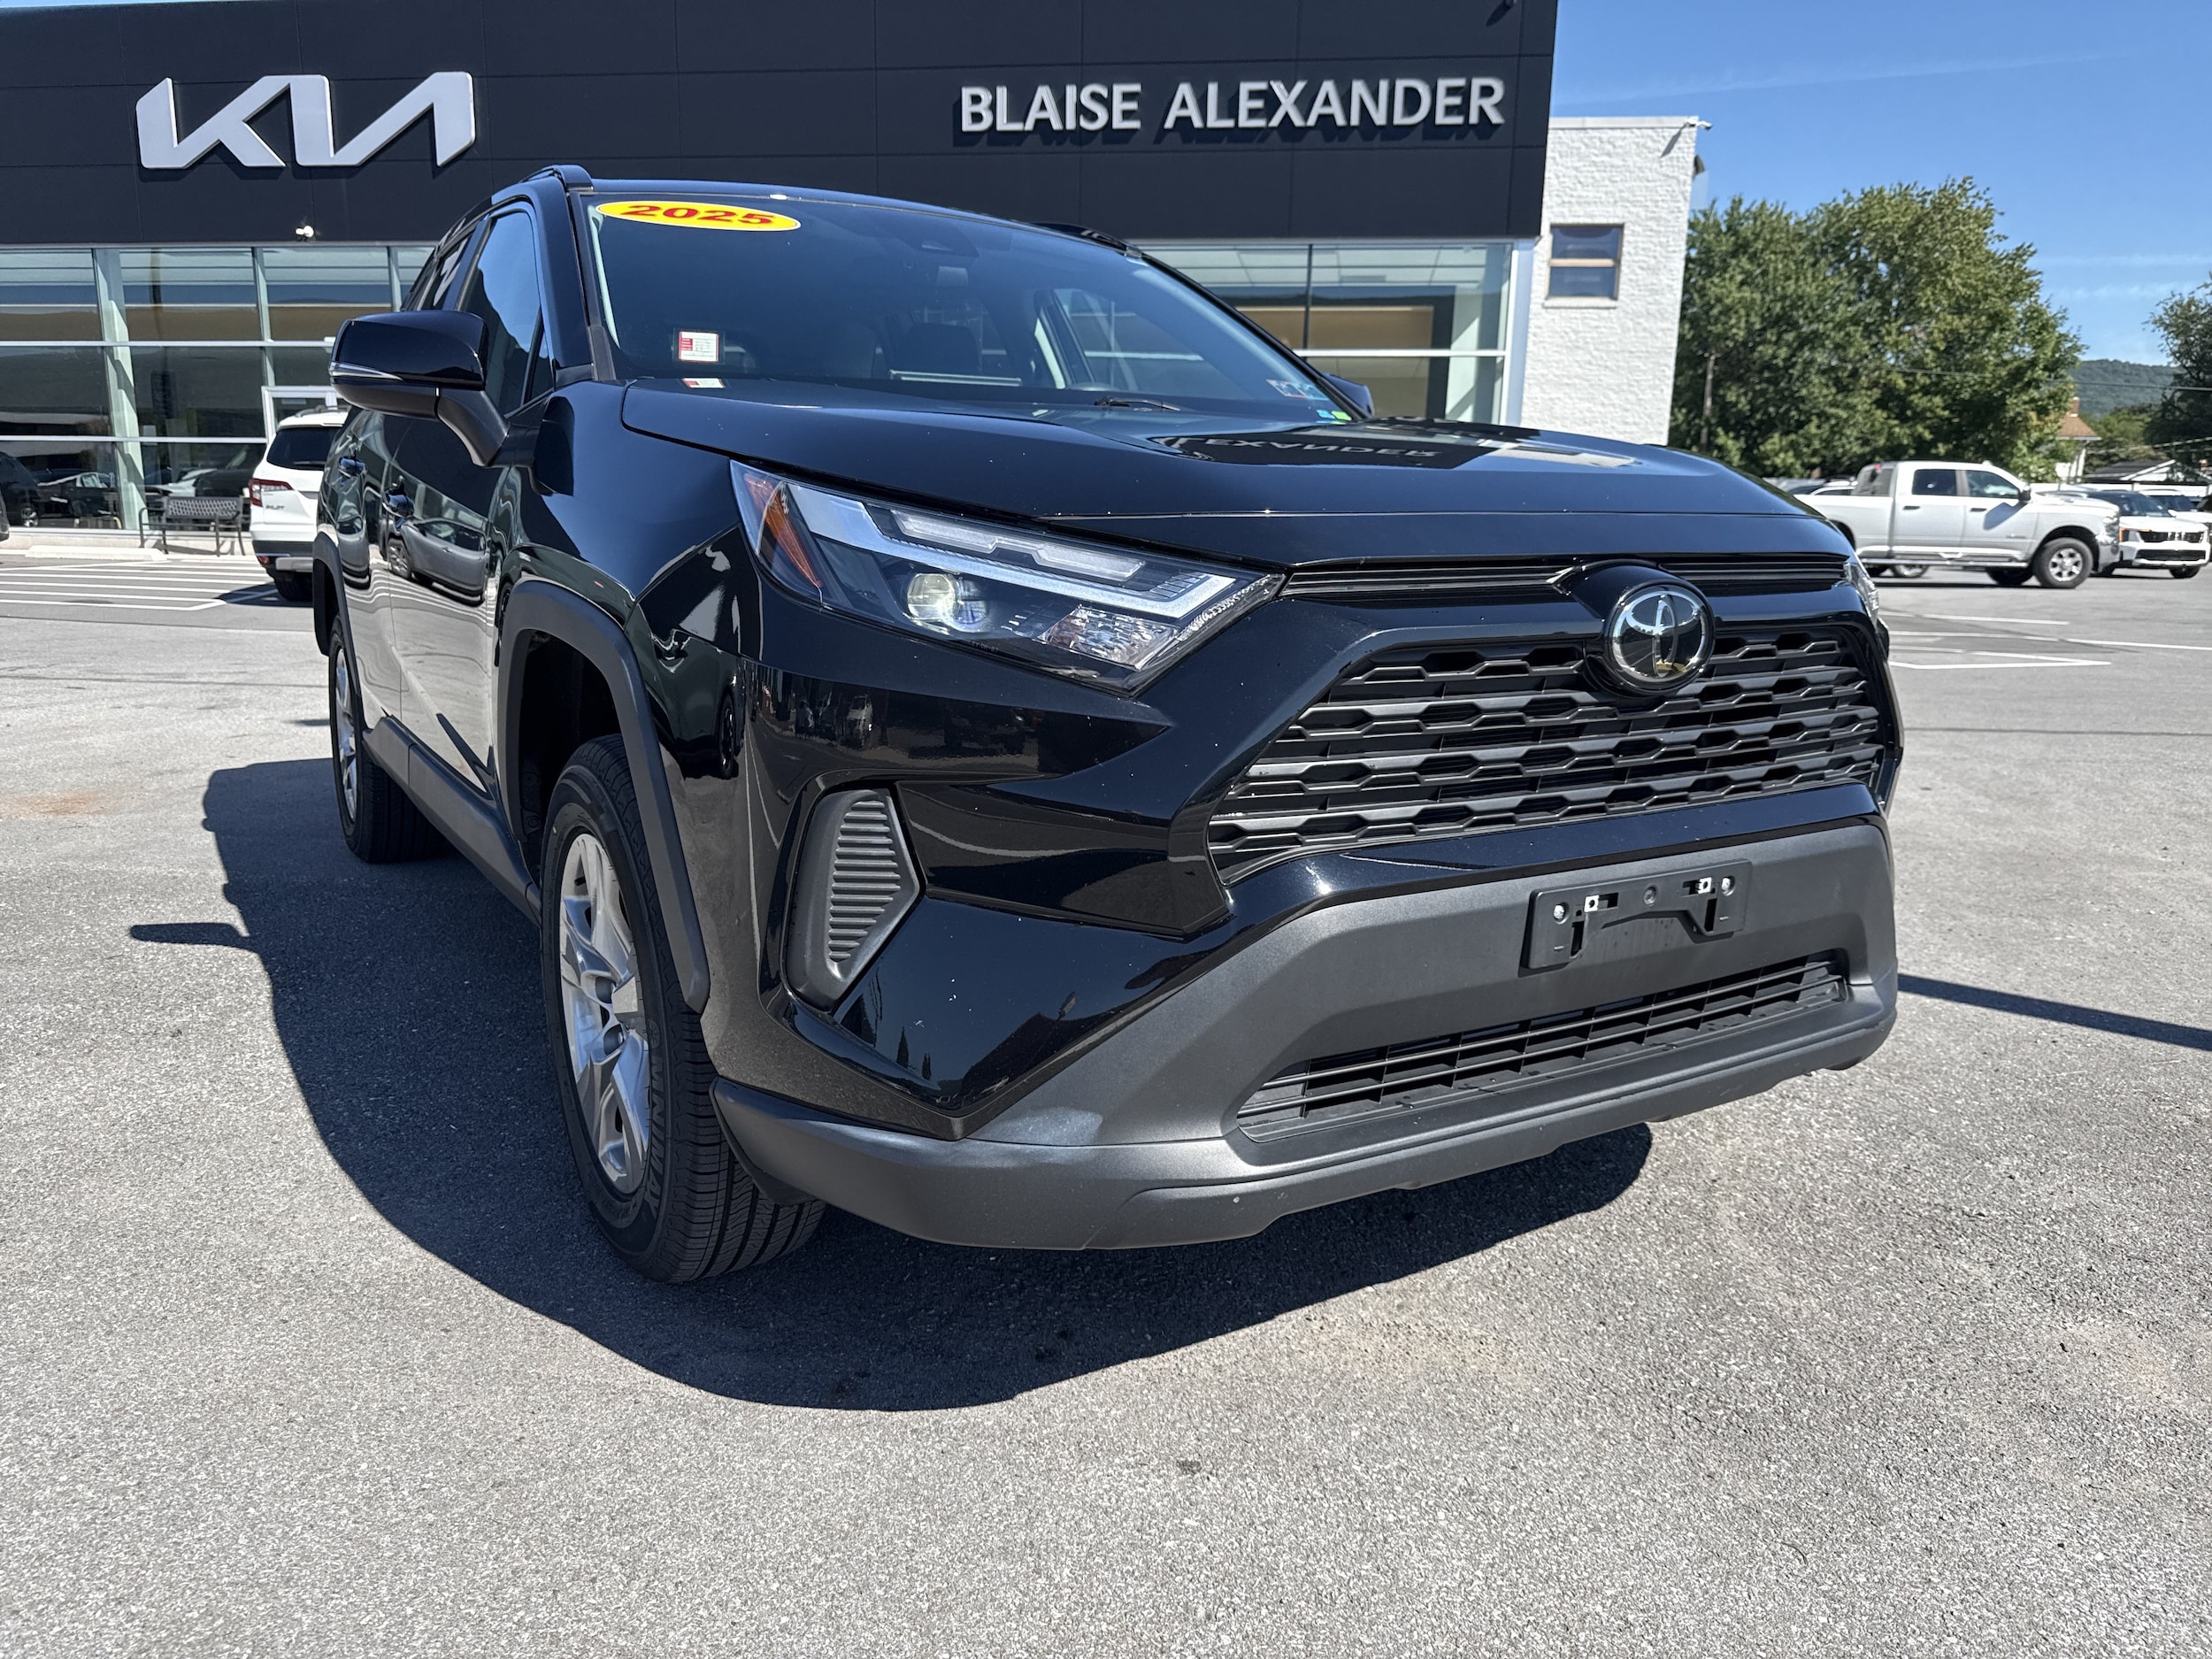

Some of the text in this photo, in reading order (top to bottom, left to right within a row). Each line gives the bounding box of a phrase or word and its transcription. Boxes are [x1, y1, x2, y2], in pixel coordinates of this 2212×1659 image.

[136, 72, 476, 169] KIA
[961, 78, 1504, 132] BLAISE ALEXANDER
[620, 204, 774, 225] 2025
